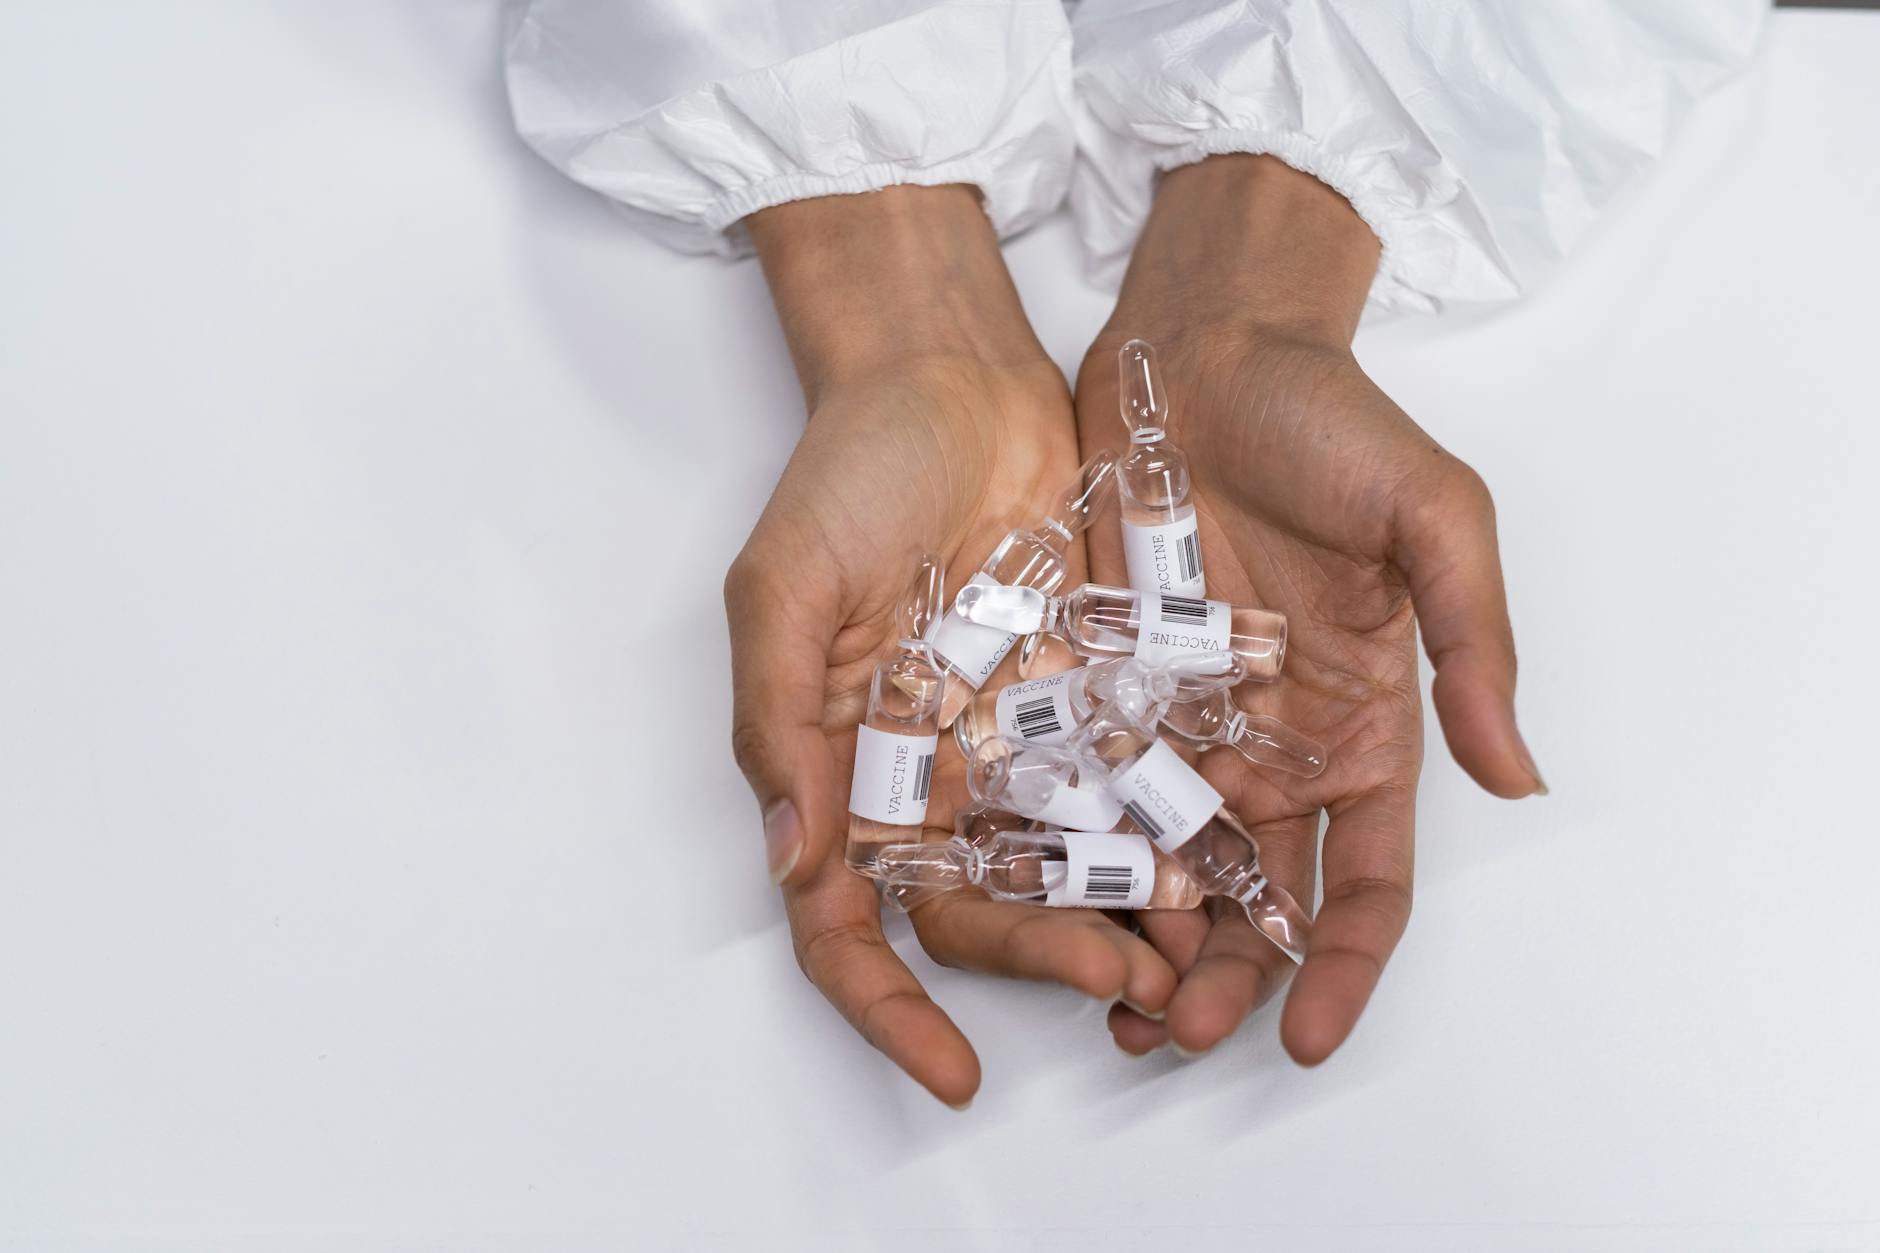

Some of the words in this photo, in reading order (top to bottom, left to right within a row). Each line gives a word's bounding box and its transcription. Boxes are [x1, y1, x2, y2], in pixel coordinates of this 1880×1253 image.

[1152, 534, 1172, 595] ACCINE
[980, 632, 1017, 675] VACCI
[1150, 632, 1219, 651] VACCINE
[1007, 676, 1064, 697] VACCINE
[1009, 719, 1019, 731] 756
[888, 745, 909, 815] VACCINE
[1134, 773, 1188, 832] VACCINE
